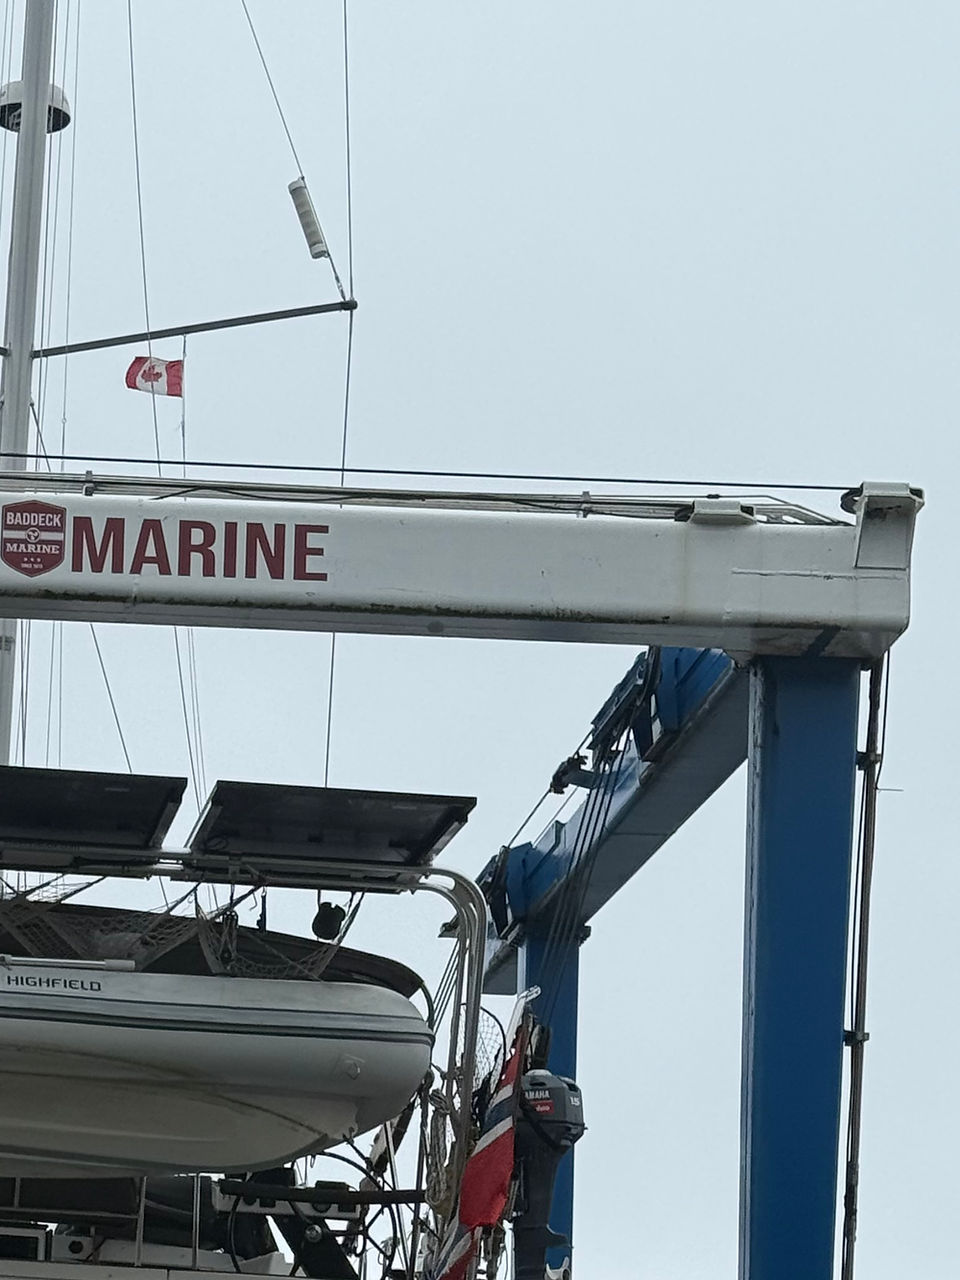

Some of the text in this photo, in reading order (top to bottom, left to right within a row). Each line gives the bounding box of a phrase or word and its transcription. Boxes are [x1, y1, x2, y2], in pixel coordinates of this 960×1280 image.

[6, 511, 62, 527] BADDECK
[5, 542, 60, 554] MARINE
[71, 516, 330, 582] MARINE
[6, 975, 102, 992] HIGHFIELD
[524, 1089, 551, 1100] AMAHA
